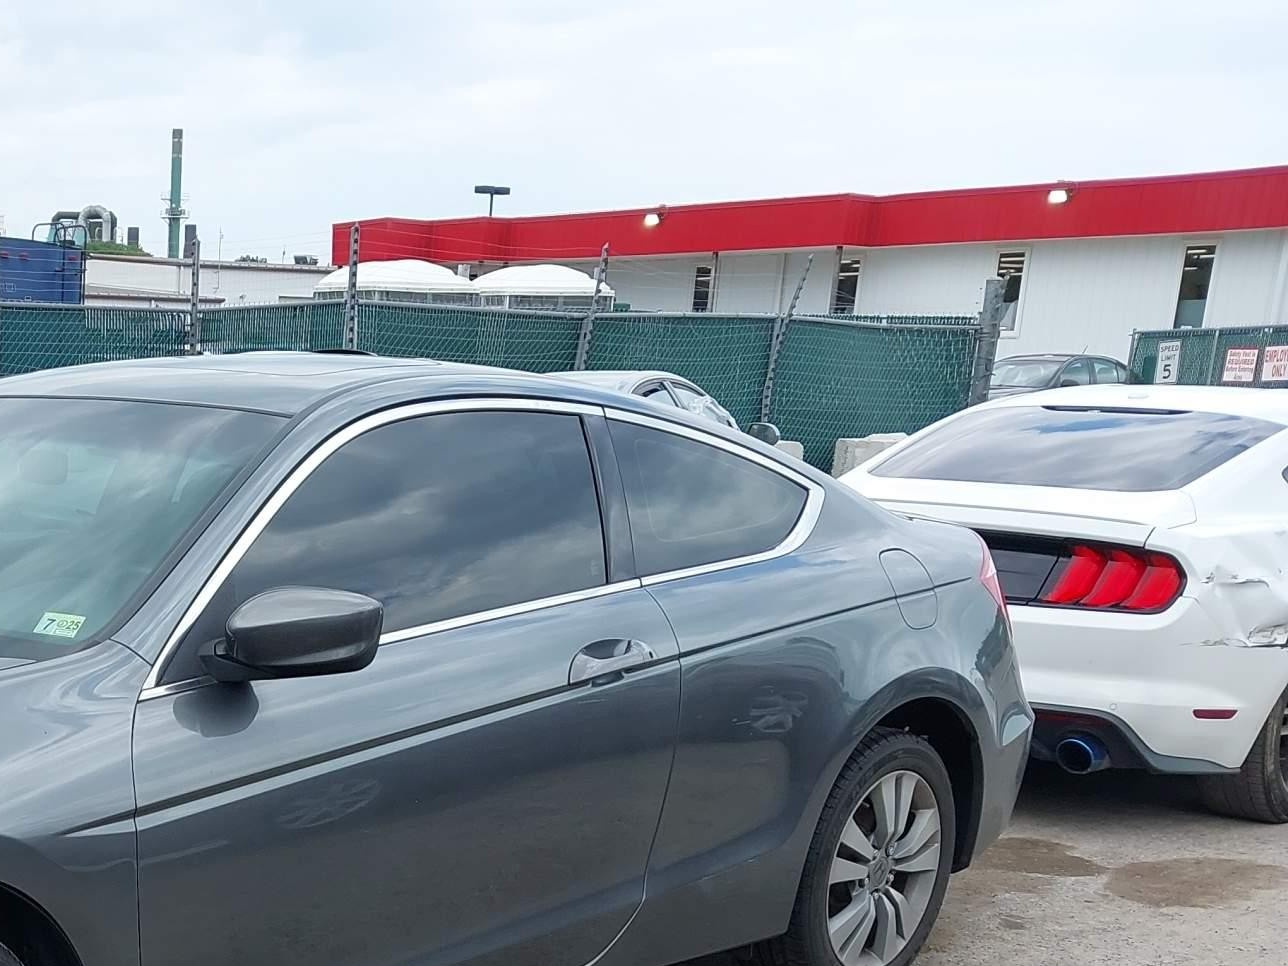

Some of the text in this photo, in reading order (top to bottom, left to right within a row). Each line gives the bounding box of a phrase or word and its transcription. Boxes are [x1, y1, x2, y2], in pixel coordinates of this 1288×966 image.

[1160, 344, 1179, 352] SPEED
[1161, 353, 1176, 361] LIMIT
[1162, 364, 1172, 379] 5
[1272, 364, 1288, 378] ONLY
[43, 617, 57, 631] 7
